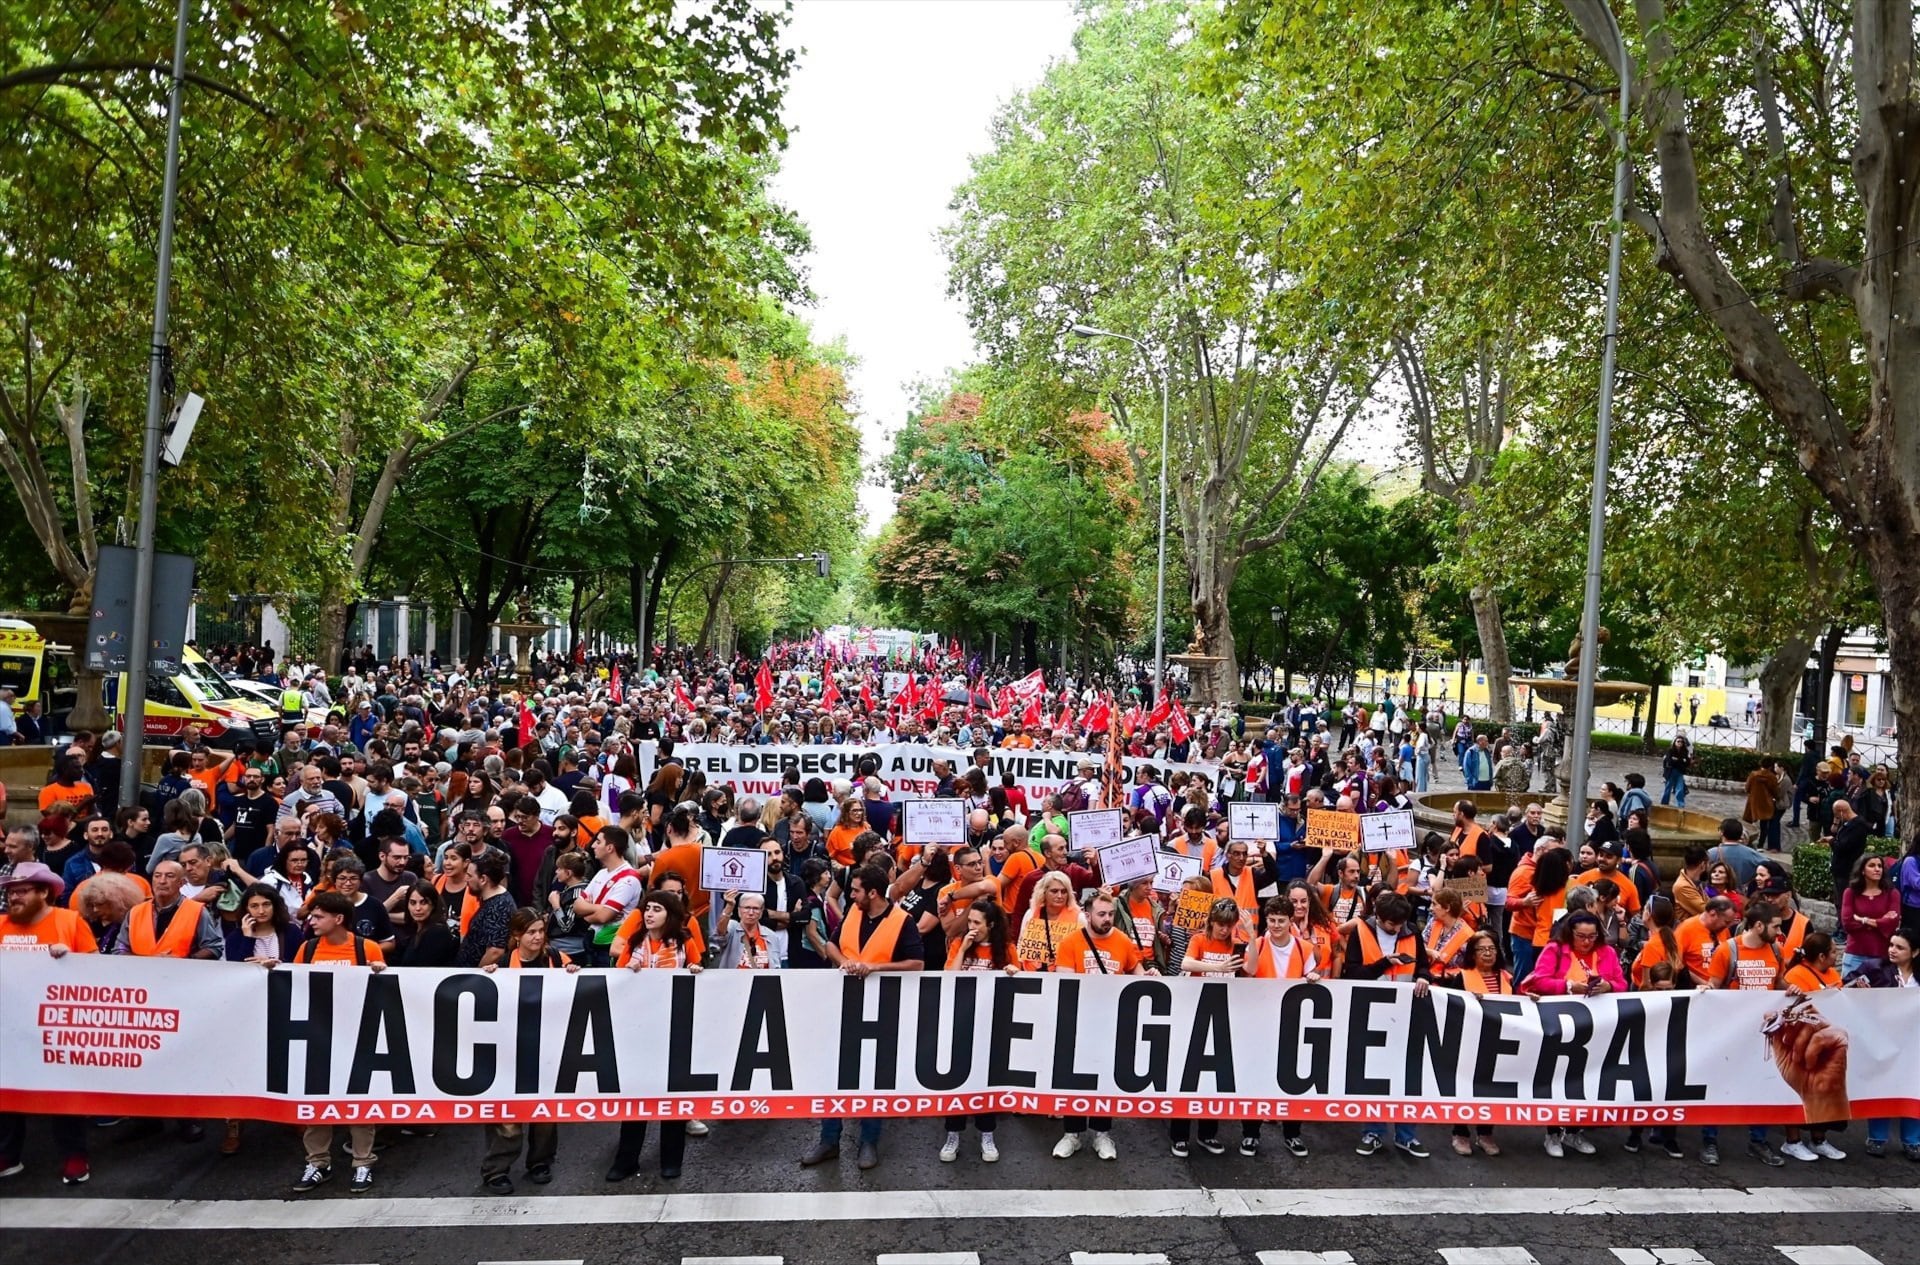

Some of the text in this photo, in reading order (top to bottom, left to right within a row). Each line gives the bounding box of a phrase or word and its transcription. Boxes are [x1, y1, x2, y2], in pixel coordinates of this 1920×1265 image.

[707, 757, 732, 773] EL
[891, 757, 905, 772] A
[1307, 827, 1352, 840] ESTAS CASAS
[1019, 948, 1042, 961] PEOR
[1021, 939, 1057, 952] SEREMS
[46, 985, 148, 1005] SINDICATO
[43, 1007, 176, 1029] DE INQUILINAS
[42, 1030, 161, 1049] E INQUILINOS
[266, 970, 1707, 1101] HACIA LA HUELGA GENERAL
[43, 1049, 143, 1068] DE MADRID
[297, 1103, 437, 1121] BAJADA
[454, 1102, 515, 1119] DEL
[532, 1099, 695, 1119] ALQUILER
[711, 1099, 770, 1115] 50%
[811, 1091, 1039, 1114] EXPROPIACIÓN
[1055, 1097, 1174, 1115] FONDOS
[1188, 1100, 1289, 1117] BUITRE
[1325, 1102, 1492, 1121] CONTRATOS
[1505, 1106, 1686, 1122] INDEFINIDOS
